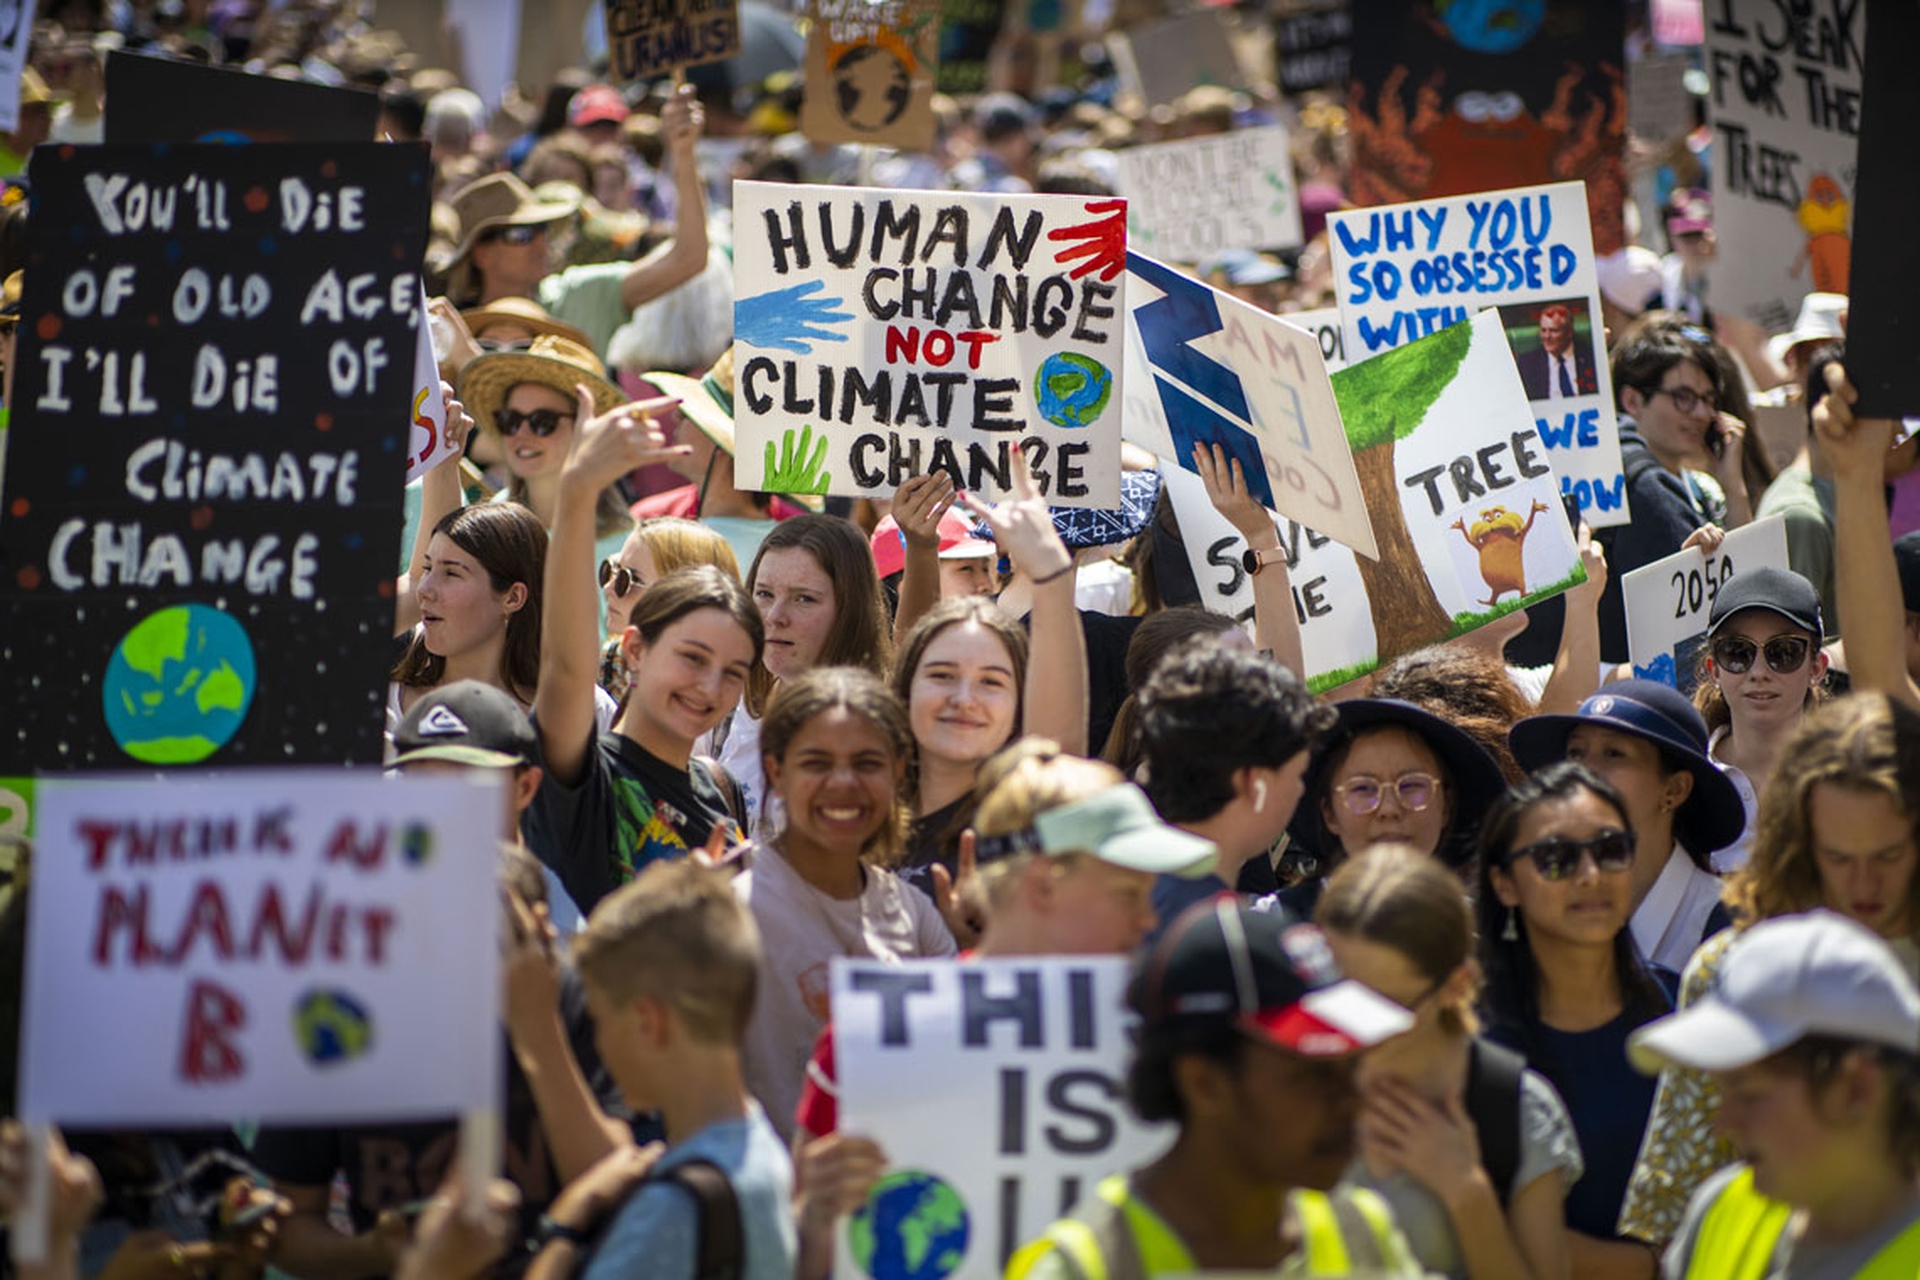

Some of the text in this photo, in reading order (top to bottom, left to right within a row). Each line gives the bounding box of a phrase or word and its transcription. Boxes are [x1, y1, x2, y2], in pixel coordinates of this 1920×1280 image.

[1711, 50, 1788, 121] FOR
[1794, 64, 1861, 138] THE
[762, 200, 1044, 274] HUMAN
[1335, 194, 1550, 258] WHY YOU
[62, 265, 420, 328] OF OLD AGE,
[862, 267, 1117, 344] CHANGE
[1349, 244, 1577, 305] SO OBSESSED
[36, 346, 158, 415] I'LL
[328, 337, 390, 398] OF
[885, 325, 1002, 370] NOT
[741, 357, 1028, 433] CLIMATE
[1536, 408, 1600, 451] WE
[1405, 428, 1551, 517] TREE
[48, 517, 320, 599] CHANGE
[178, 978, 248, 1087] B
[850, 968, 1098, 1051] THI
[998, 1068, 1121, 1158] IS
